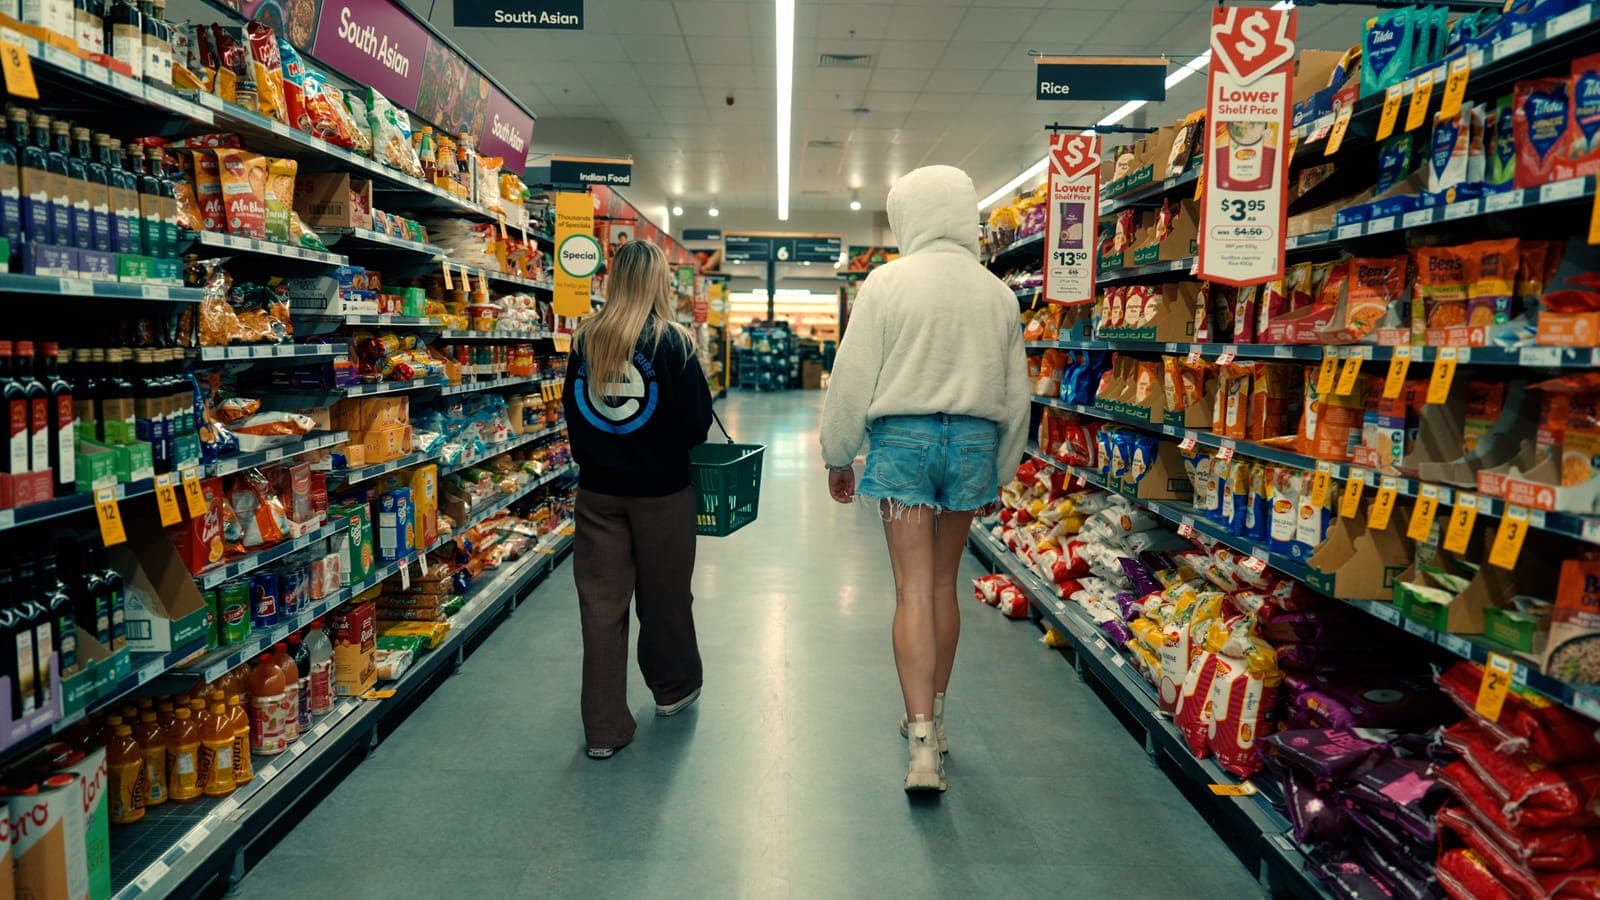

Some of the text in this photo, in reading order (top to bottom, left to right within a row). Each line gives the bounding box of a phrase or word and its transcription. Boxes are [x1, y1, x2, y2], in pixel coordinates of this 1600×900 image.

[494, 10, 579, 25] South Asian
[338, 6, 409, 78] South Asian
[1371, 29, 1394, 45] Tilda
[1040, 82, 1070, 94] Rice
[1218, 86, 1280, 103] Lower
[1218, 105, 1279, 115] Shelf Price
[492, 113, 524, 154] South Asian
[580, 172, 630, 184] Indian Food
[1054, 182, 1092, 193] Lower
[557, 213, 592, 222] Thousands
[562, 250, 597, 261] Special
[776, 246, 789, 261] 6
[1429, 255, 1464, 272] Ben's
[1358, 264, 1391, 279] Ben's
